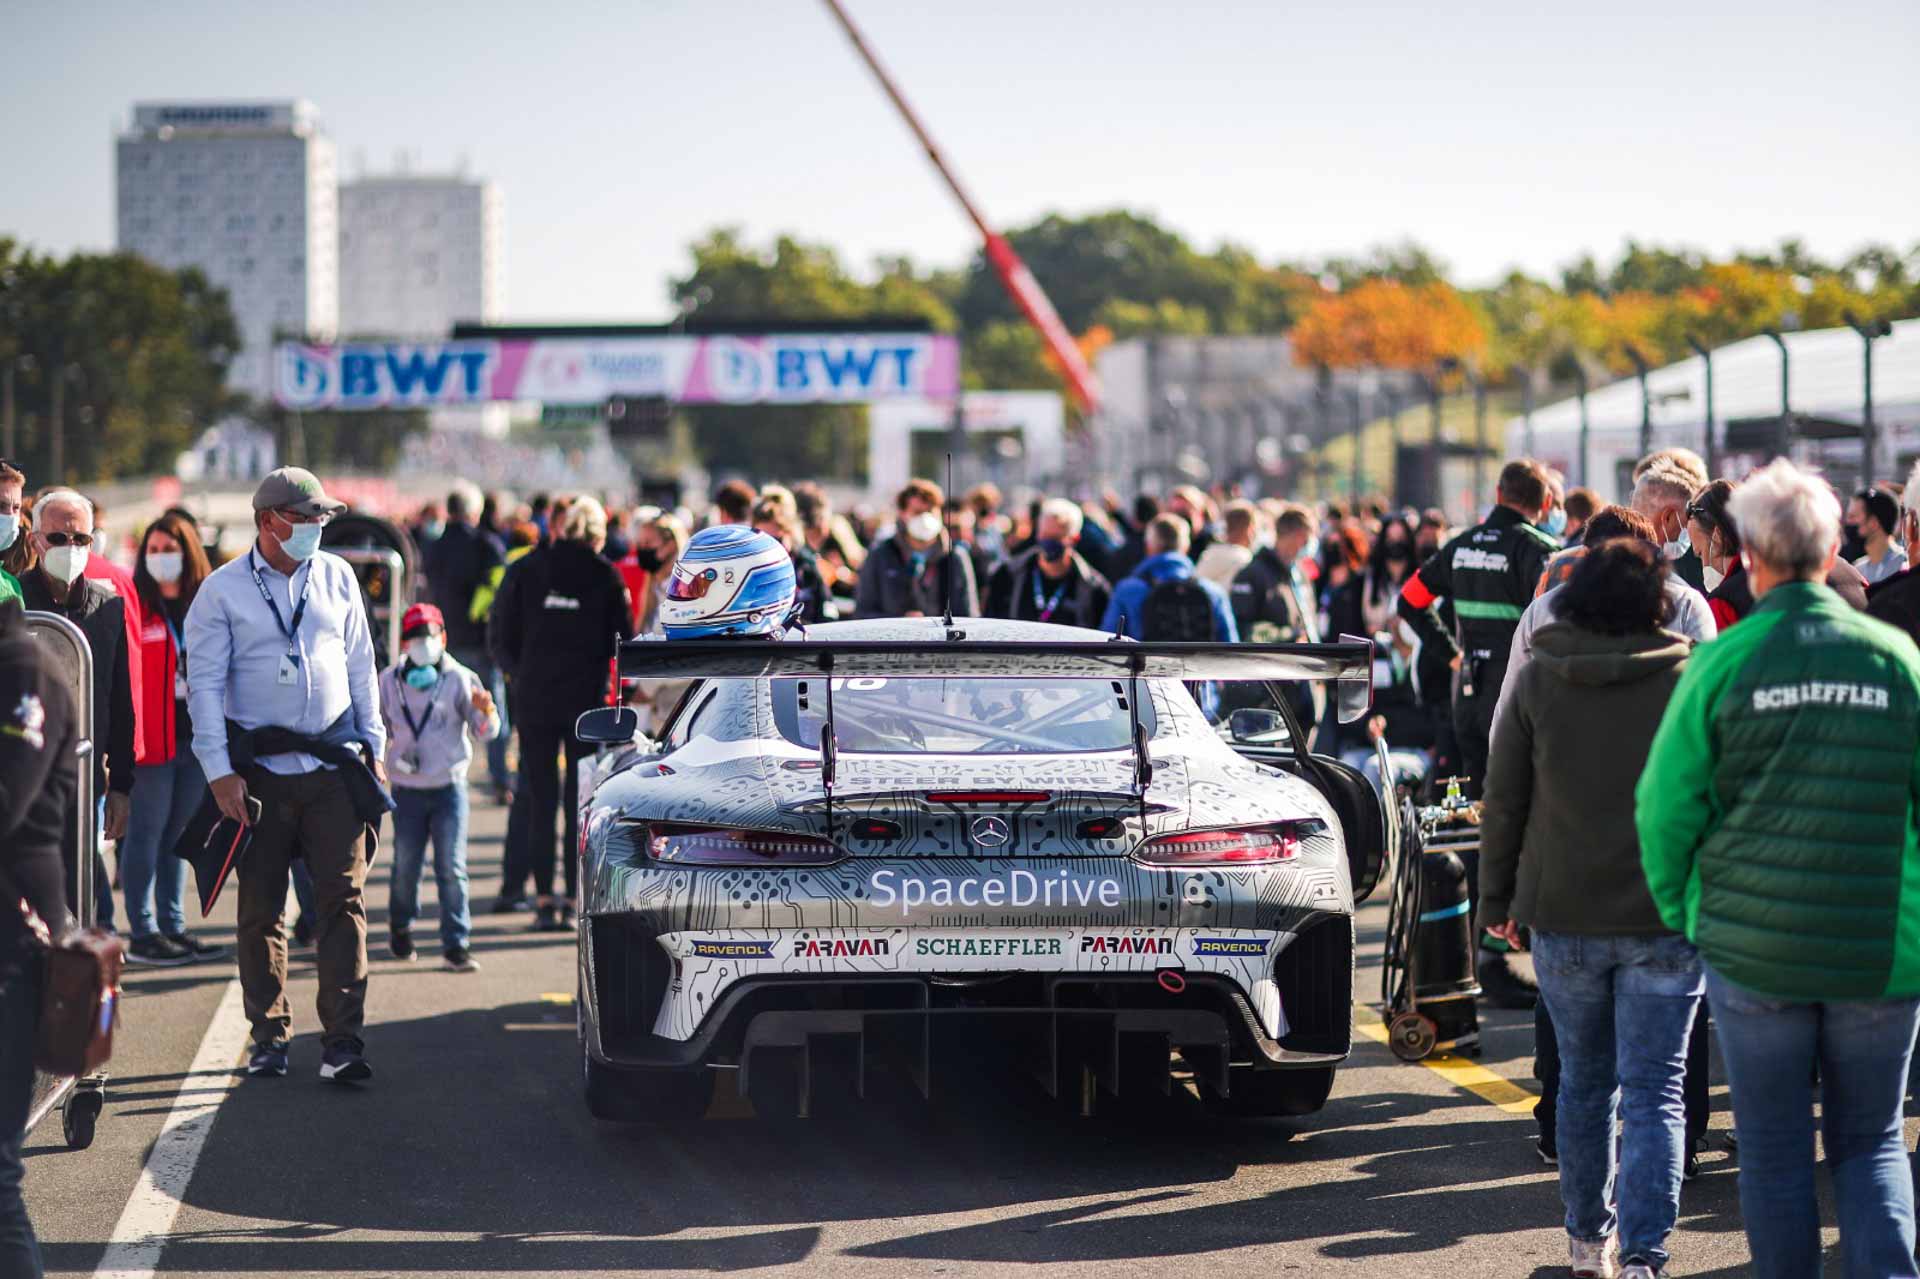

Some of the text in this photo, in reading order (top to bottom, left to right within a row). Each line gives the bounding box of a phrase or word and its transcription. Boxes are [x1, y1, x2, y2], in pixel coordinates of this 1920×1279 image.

[341, 352, 488, 395] BWT
[777, 347, 916, 388] BWT
[870, 869, 1121, 917] SpaceDrive
[697, 945, 766, 955] RAVENOL
[794, 938, 889, 957] PARAVAN
[916, 938, 1062, 956] SCHAEFFLER
[1082, 936, 1173, 954] PARAVAN
[1201, 942, 1263, 952] RAVENOL
